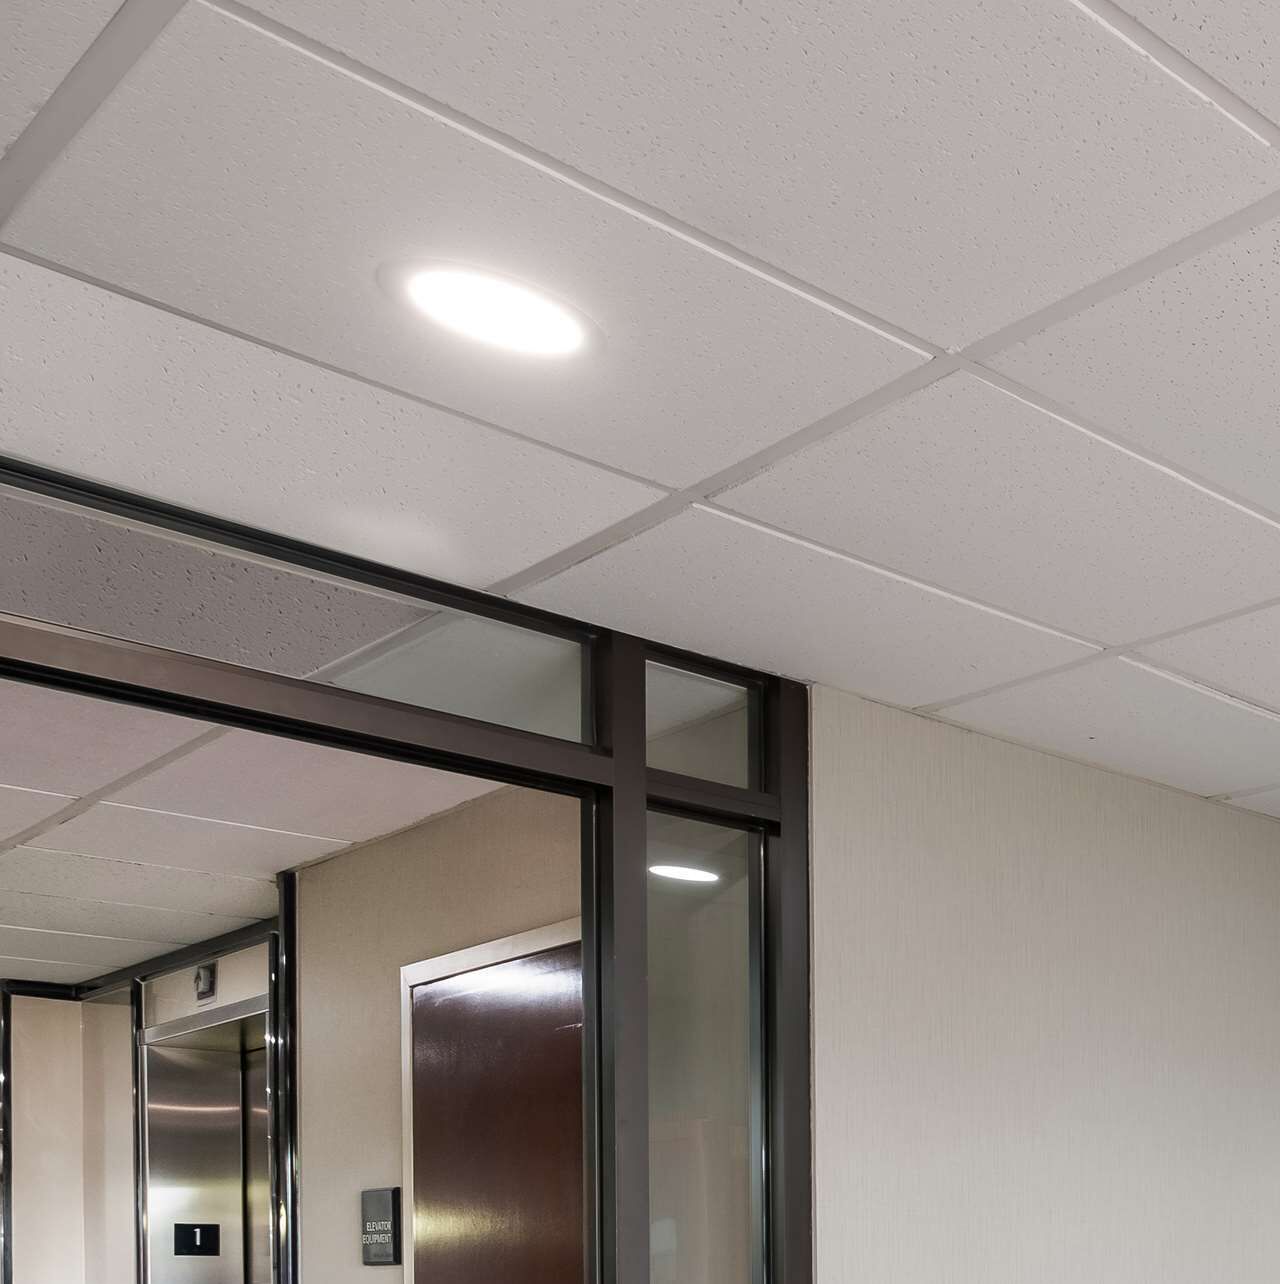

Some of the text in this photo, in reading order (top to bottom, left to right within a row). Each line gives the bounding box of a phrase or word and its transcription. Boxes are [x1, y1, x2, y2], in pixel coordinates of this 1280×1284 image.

[366, 1221, 392, 1231] ELEVATOR
[193, 1228, 201, 1246] 1
[362, 1233, 392, 1245] EQUIPMENT
